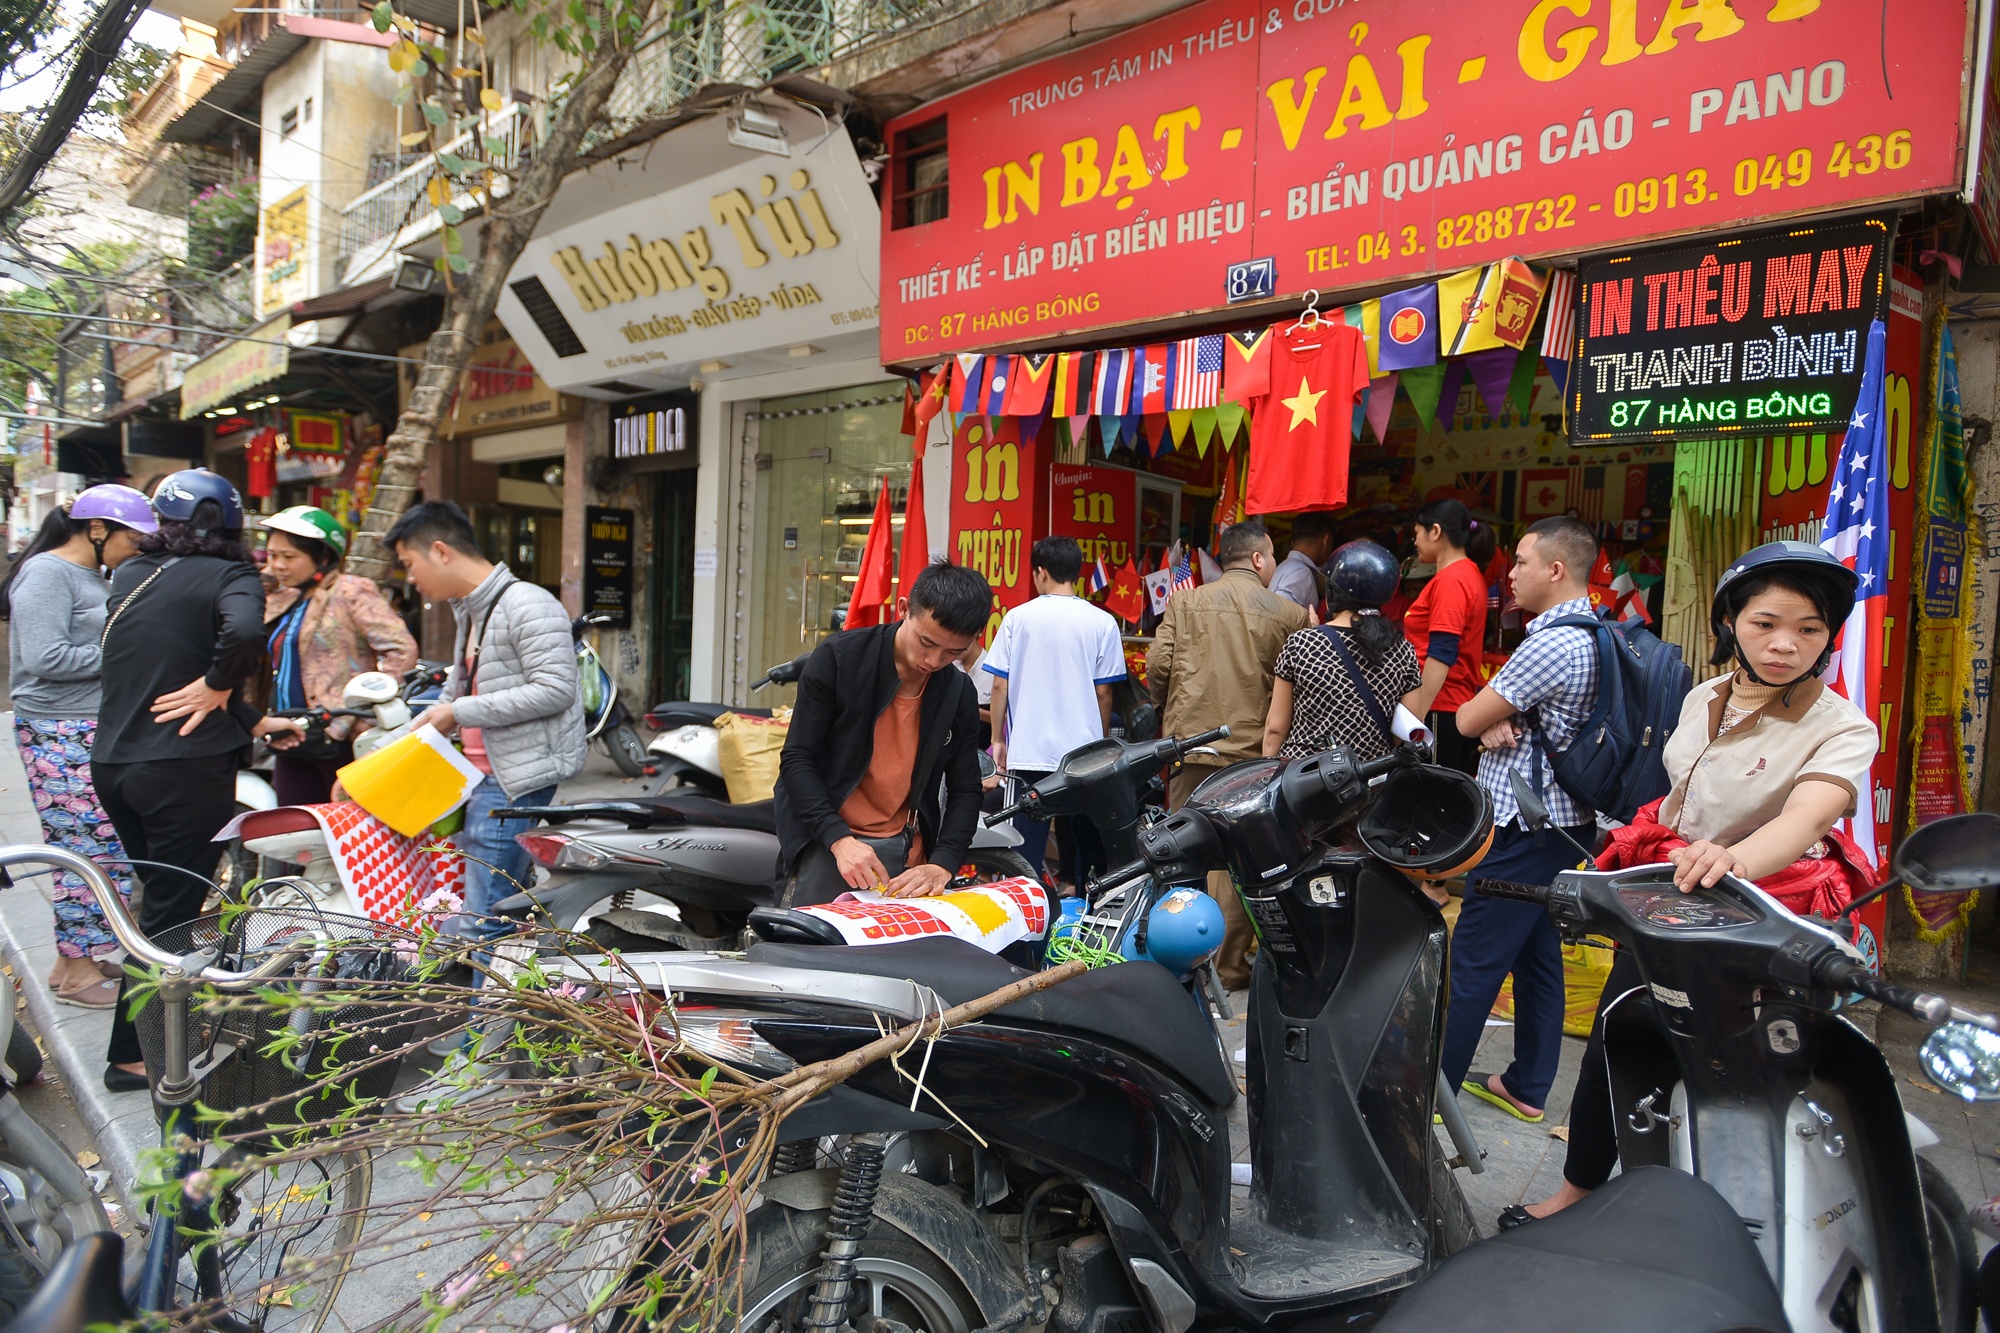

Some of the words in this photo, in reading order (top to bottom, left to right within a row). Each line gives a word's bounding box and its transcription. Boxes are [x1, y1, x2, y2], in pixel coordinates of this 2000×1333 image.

[1009, 76, 1084, 118] TRUNG
[1091, 58, 1142, 90] TÂM
[1149, 43, 1173, 72] IN
[1182, 17, 1256, 60] THÊU
[983, 151, 1044, 230] IN
[1060, 104, 1201, 211] BẠT
[1265, 20, 1433, 152] VẢI
[898, 261, 951, 304] THIẾT
[955, 250, 985, 293] KẾ
[1003, 241, 1045, 283] LẮP
[1051, 230, 1098, 274] ĐẶT
[1105, 207, 1168, 260] BIỂN
[1176, 198, 1246, 245] HIỆU
[1286, 160, 1370, 222] BIỂN
[1381, 133, 1524, 202] QUẢNG
[1537, 107, 1635, 165] CÁO
[1688, 59, 1848, 134] PANO
[1305, 246, 1350, 274] TEL:
[1356, 229, 1392, 266] 04
[1436, 193, 1578, 251] 8288732
[1613, 167, 1719, 219] 0913.
[1733, 146, 1813, 198] 049
[1826, 128, 1913, 180] 436
[550, 225, 732, 314] Hương
[709, 167, 842, 269] Túi
[1231, 258, 1273, 297] 87
[938, 312, 967, 339] 87
[971, 303, 1030, 334] HÀNG
[1035, 291, 1101, 322] BÔNG
[1588, 277, 1634, 339] IN
[1642, 253, 1753, 332] THÊU
[1762, 244, 1874, 319] MAY
[1589, 341, 1735, 394] THANH
[1740, 324, 1858, 382] BÌNH
[1609, 398, 1652, 429] 87
[1658, 397, 1737, 425] HÀNG
[1745, 390, 1832, 420] BÔNG
[964, 423, 1021, 503] in
[1071, 488, 1117, 524] in
